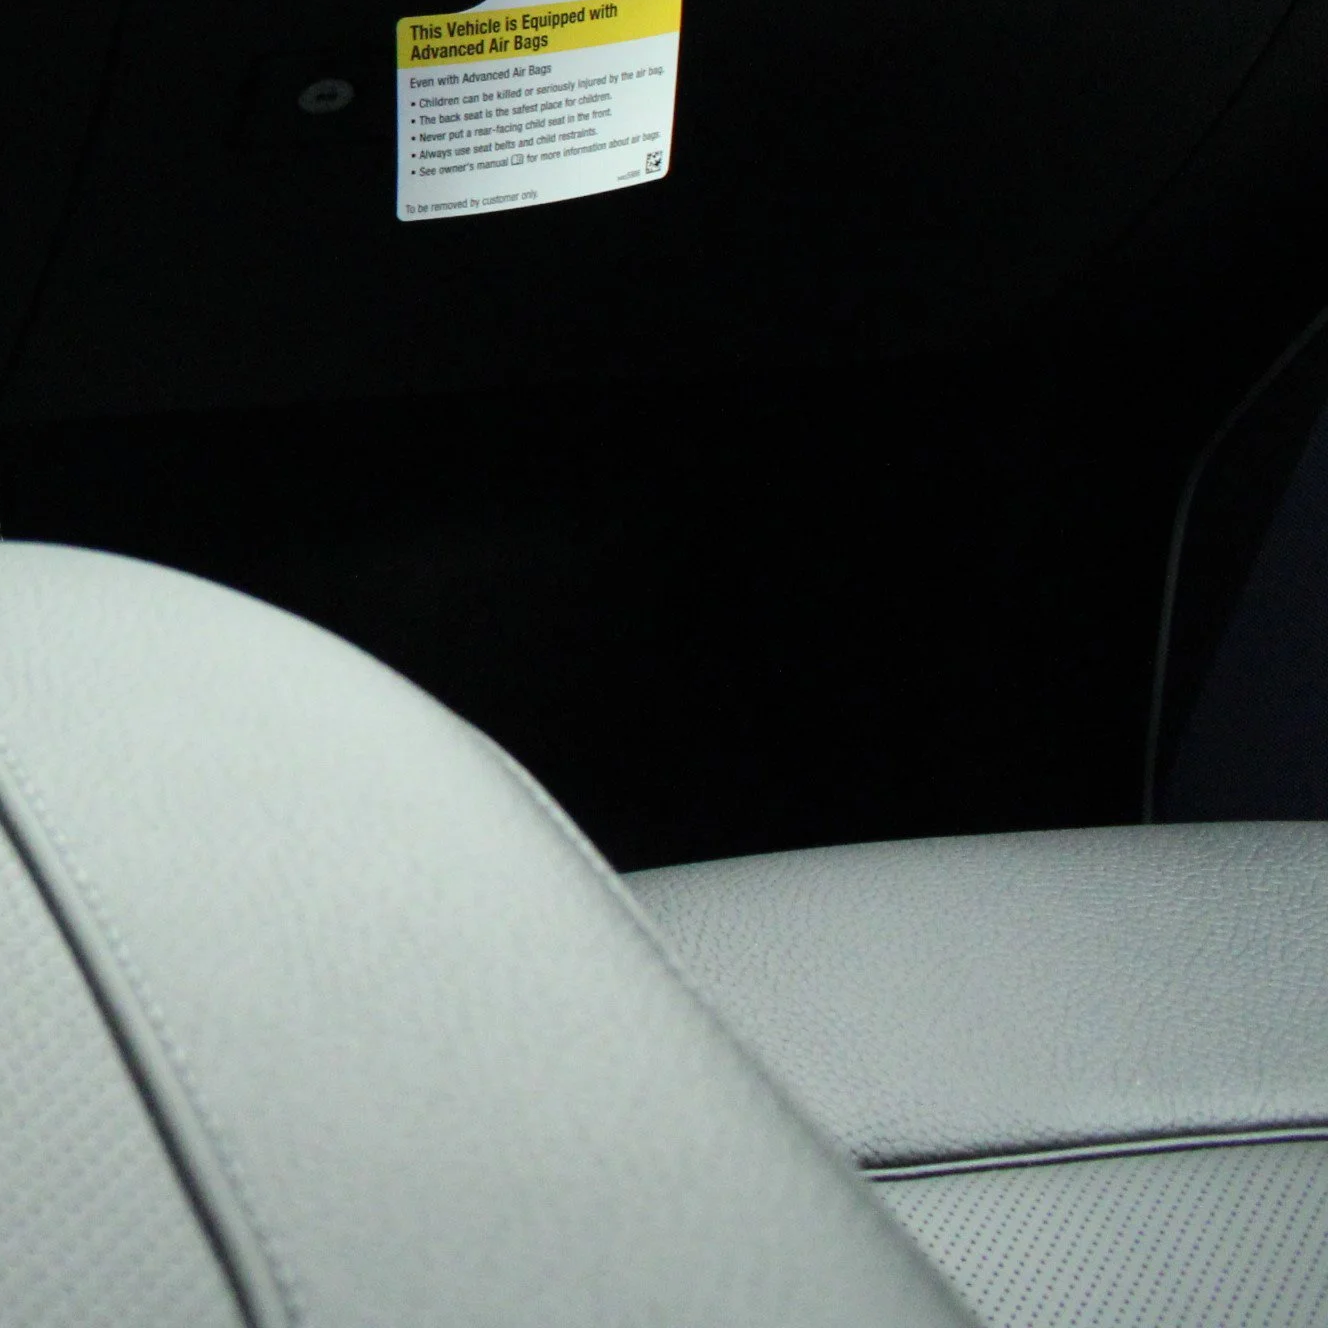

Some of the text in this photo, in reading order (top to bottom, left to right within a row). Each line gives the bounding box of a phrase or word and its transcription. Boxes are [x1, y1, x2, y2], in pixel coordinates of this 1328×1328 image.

[410, 3, 618, 40] This Vehicle is Equipped with
[411, 34, 548, 61] Advanced Air Bags
[410, 64, 552, 89] Even with Advanced Air Bags
[419, 97, 460, 108] Children
[462, 95, 480, 104] can
[482, 92, 494, 102] be
[497, 88, 522, 99] killed
[524, 88, 534, 97] or
[536, 81, 575, 95] seriously
[577, 76, 607, 90] injured
[609, 74, 619, 84] by
[621, 71, 634, 81] the
[636, 69, 646, 78] air
[419, 92, 612, 125] The back seat is the safest place for children.
[419, 133, 446, 142] Never
[449, 130, 464, 141] put
[466, 130, 472, 138] a
[474, 122, 523, 136] rear-facing
[525, 117, 546, 130] child
[548, 116, 565, 126] seat
[567, 114, 575, 123] in
[577, 112, 590, 121] the
[419, 148, 452, 160] Always
[455, 146, 471, 156] use
[473, 143, 492, 153] seat
[494, 140, 516, 151] belts
[518, 137, 534, 147] and
[536, 133, 556, 145] child
[419, 167, 436, 177] See
[477, 157, 508, 169] manual
[526, 153, 538, 163] for
[540, 151, 561, 161] more
[563, 142, 606, 157] information
[608, 137, 629, 149] about
[631, 135, 641, 144] air
[405, 204, 415, 214] To
[417, 203, 428, 213] be
[431, 200, 467, 212] removed
[470, 198, 480, 208] by
[482, 192, 519, 206] customer
